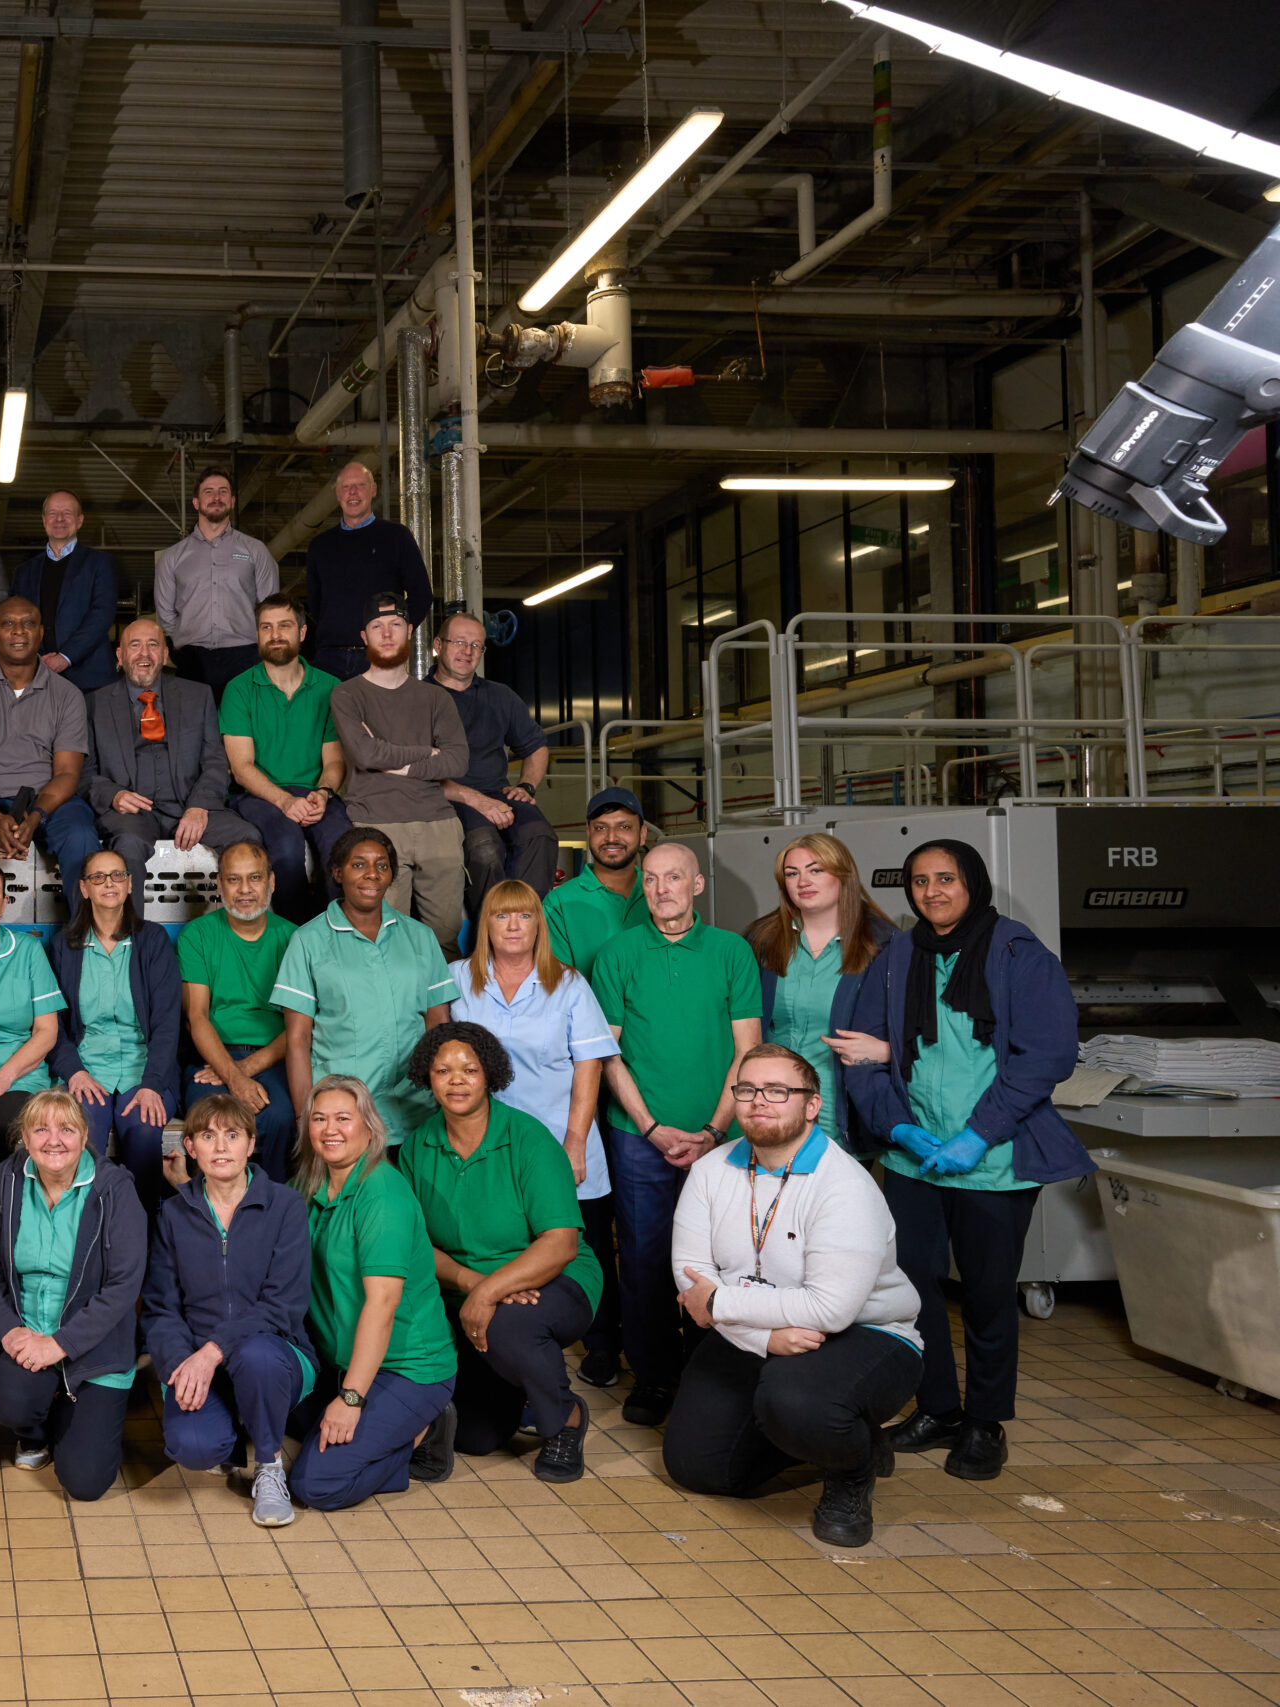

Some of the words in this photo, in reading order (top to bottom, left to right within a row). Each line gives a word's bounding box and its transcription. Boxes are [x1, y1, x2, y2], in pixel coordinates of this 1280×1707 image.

[1120, 410, 1159, 451] Profoto
[1108, 847, 1158, 867] FRB
[874, 871, 904, 885] GIR
[1088, 891, 1184, 906] GIRBAU
